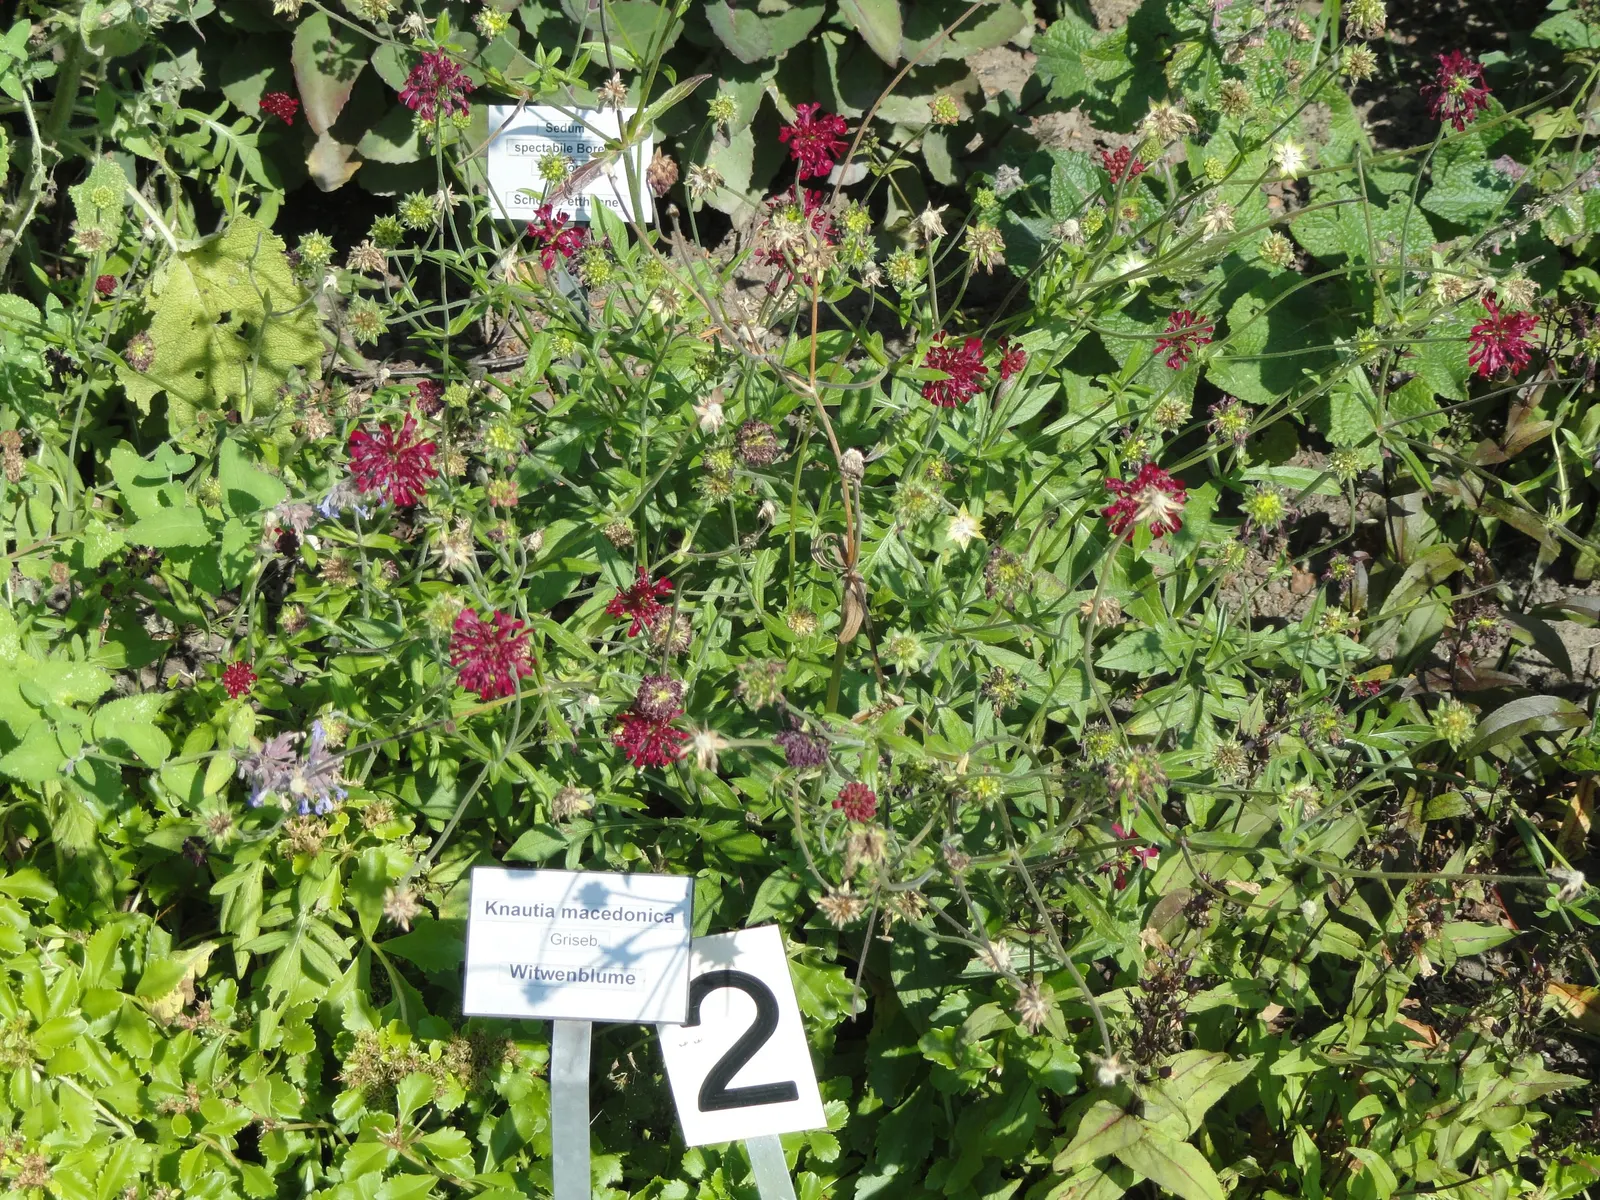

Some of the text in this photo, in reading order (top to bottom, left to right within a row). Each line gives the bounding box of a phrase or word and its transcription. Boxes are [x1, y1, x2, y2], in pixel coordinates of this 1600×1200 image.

[545, 122, 585, 134] Sedum
[514, 143, 573, 155] spectabile
[485, 900, 675, 924] Knautia macedonica
[509, 963, 636, 985] Witwenblume
[680, 969, 799, 1112] 2
